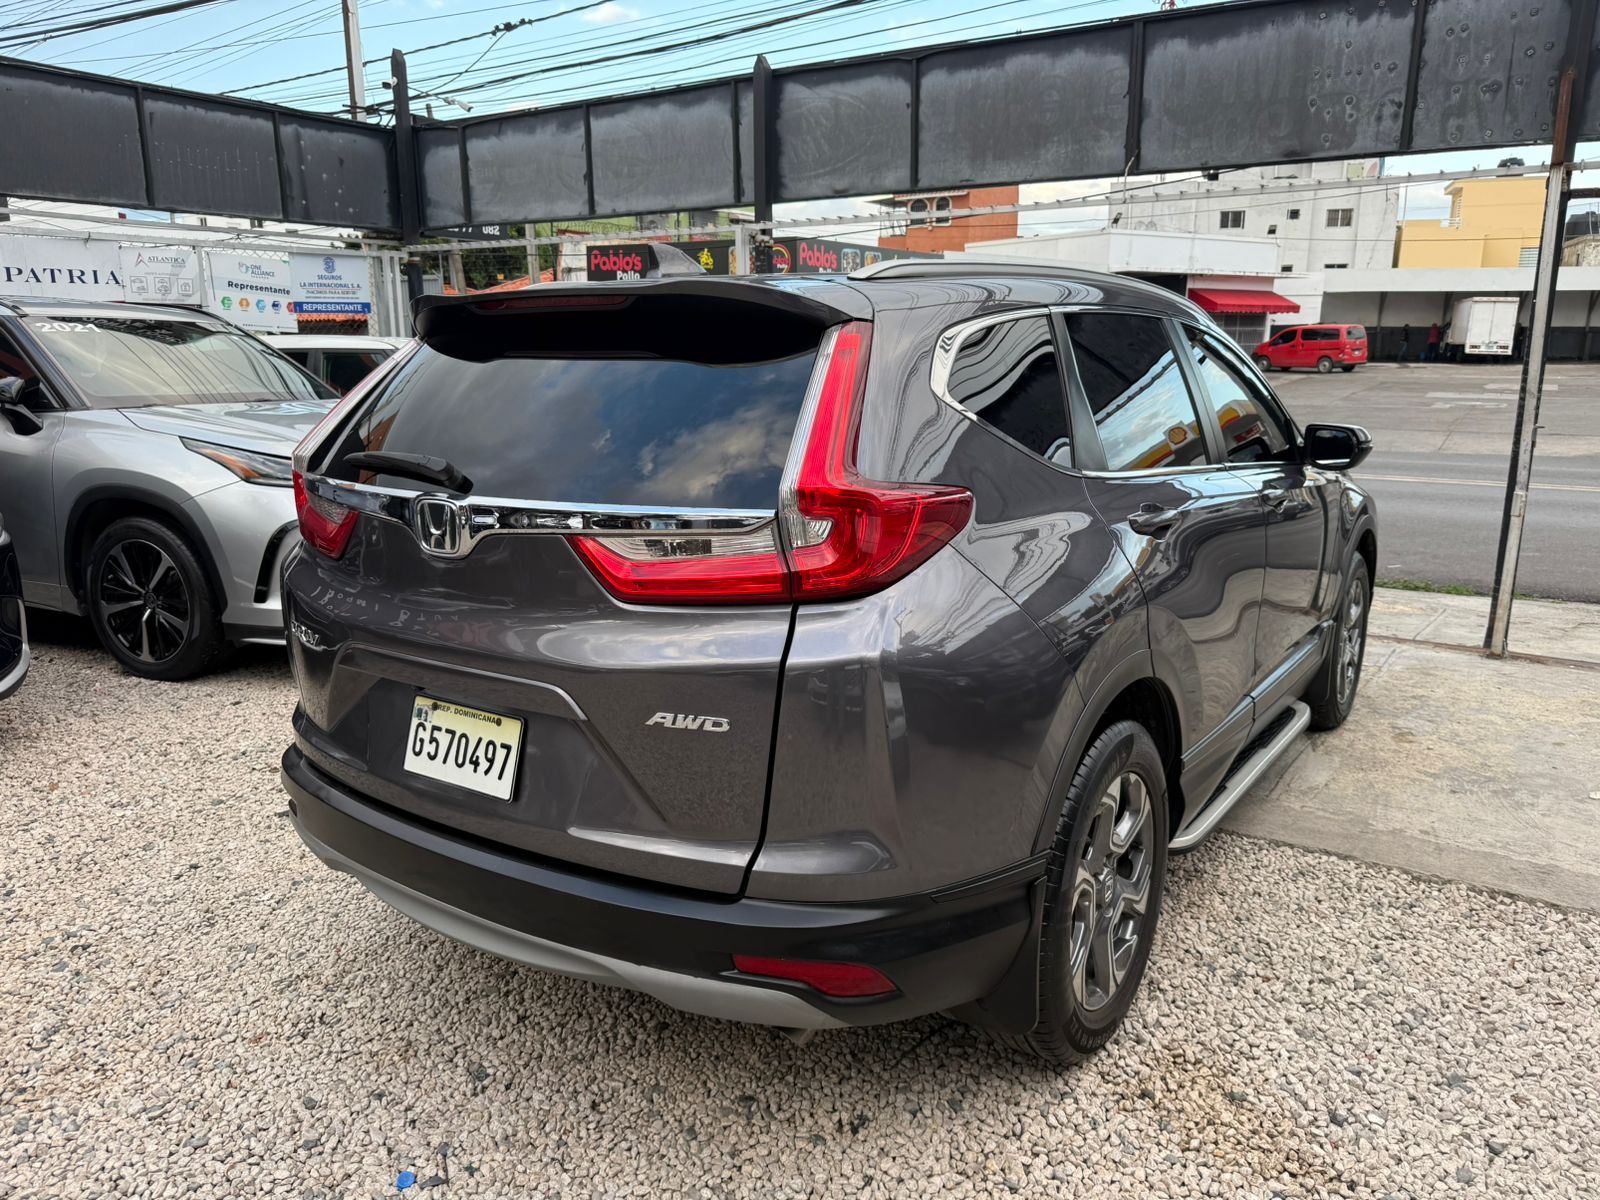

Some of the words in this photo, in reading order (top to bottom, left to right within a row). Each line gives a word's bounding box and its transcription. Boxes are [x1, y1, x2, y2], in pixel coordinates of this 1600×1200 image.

[591, 250, 642, 271] Pablo's
[800, 242, 838, 270] Pablo's
[3, 267, 121, 285] PATRIA
[251, 269, 275, 277] ALLIANCE
[227, 281, 290, 295] Representante
[303, 303, 363, 311] REPRESENTANTE
[36, 322, 102, 333] 2021
[437, 704, 453, 713] REP.
[454, 707, 497, 724] DOMINICANA
[644, 712, 730, 732] AWD
[412, 722, 512, 780] G570497
